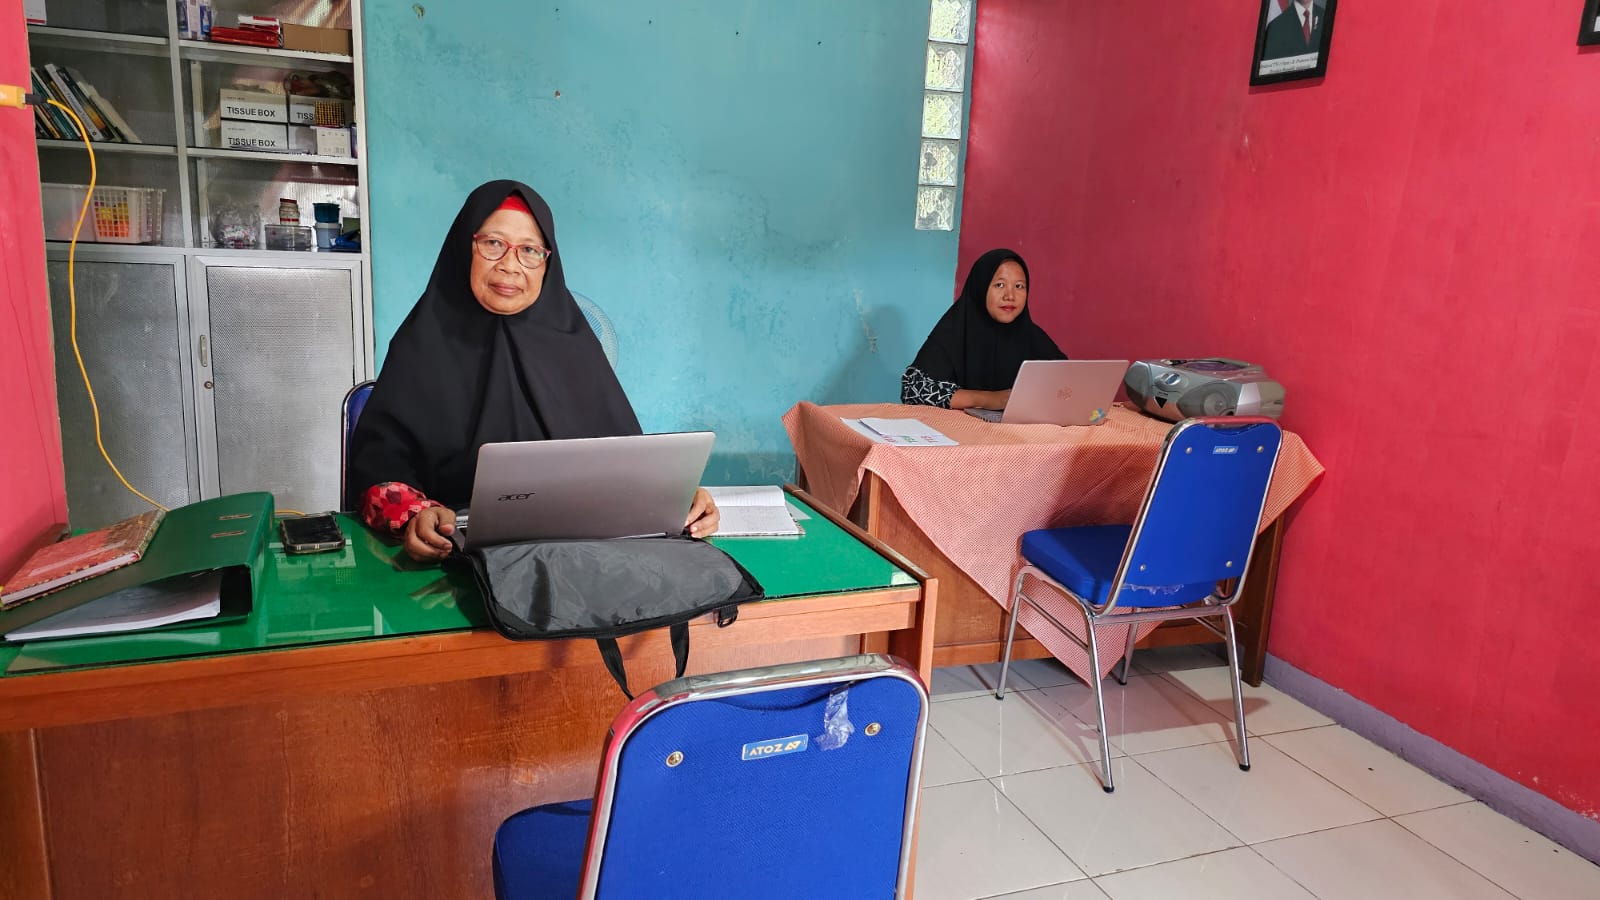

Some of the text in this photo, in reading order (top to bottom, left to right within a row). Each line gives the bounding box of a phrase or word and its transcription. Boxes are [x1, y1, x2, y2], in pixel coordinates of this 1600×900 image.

[227, 107, 257, 116] TISSUE
[296, 112, 314, 120] TISS
[228, 137, 276, 147] TISSUE BOX
[498, 492, 536, 501] acer
[749, 743, 783, 756] ATOZ
